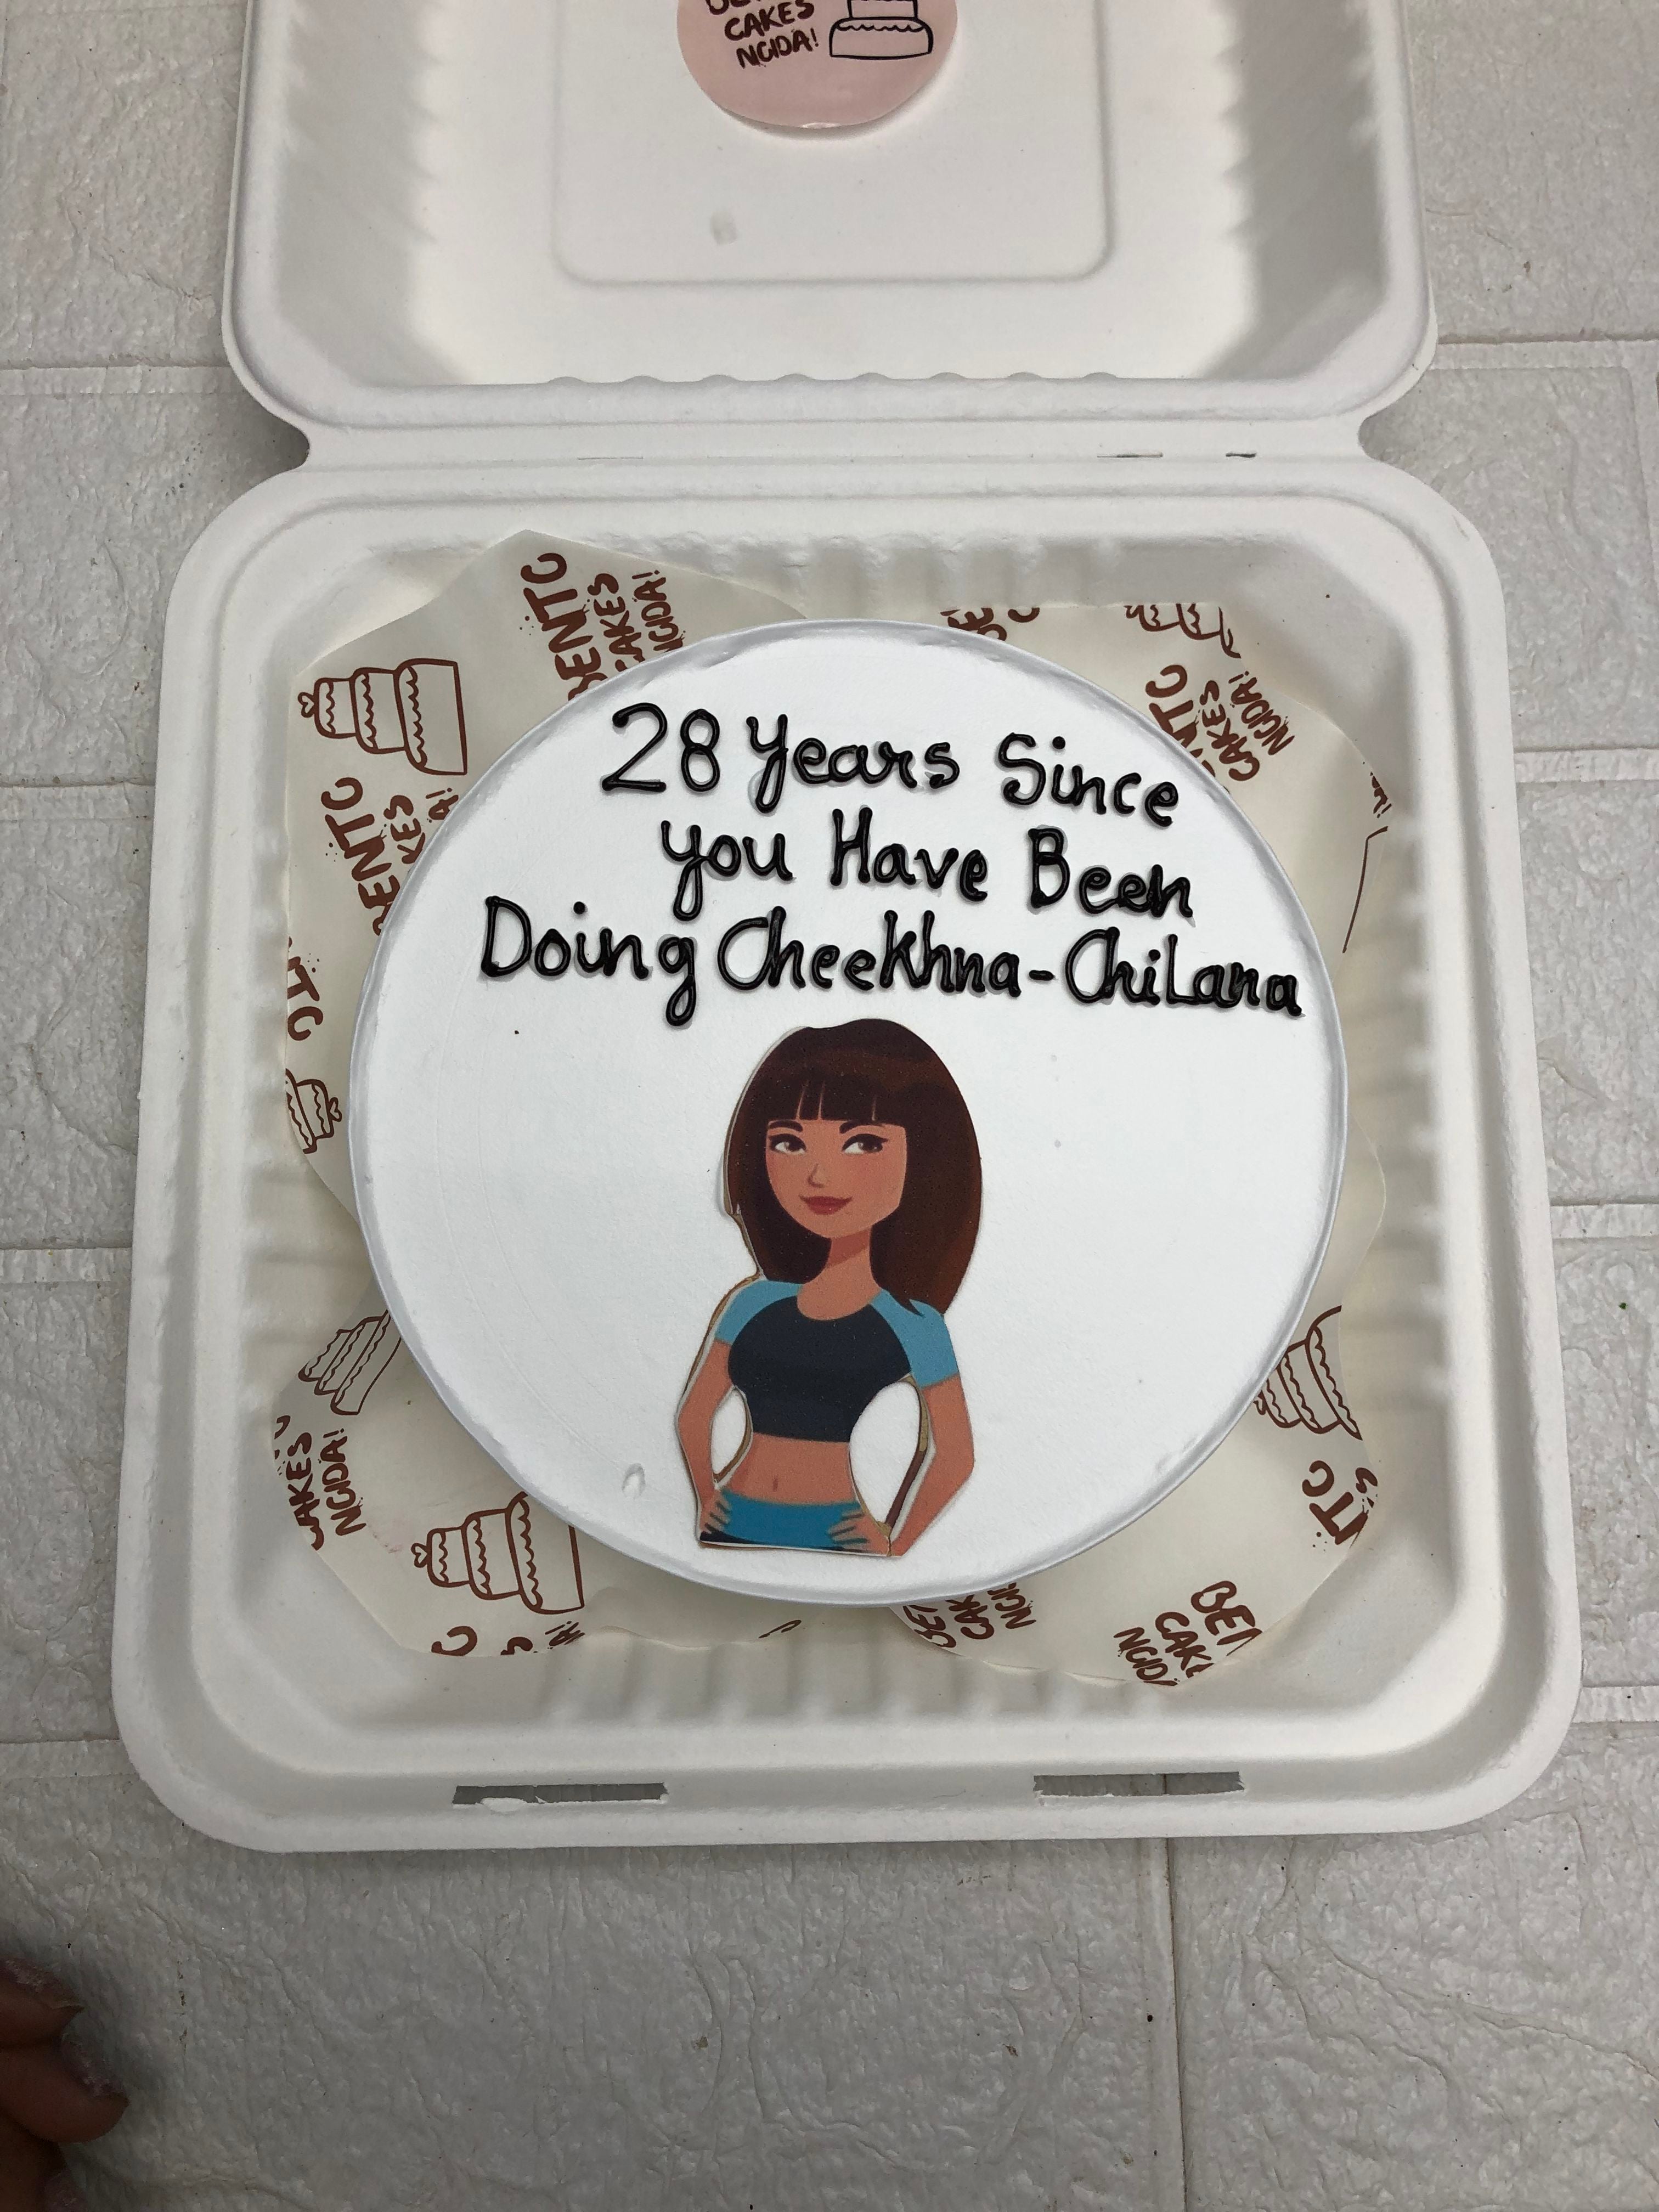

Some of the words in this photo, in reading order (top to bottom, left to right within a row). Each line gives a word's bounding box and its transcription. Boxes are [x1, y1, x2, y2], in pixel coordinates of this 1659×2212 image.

[724, 0, 815, 41] CAKES
[601, 702, 720, 792] 28
[997, 732, 1180, 827] Since
[1199, 680, 1260, 782] CAKES
[383, 794, 426, 865] KES
[830, 806, 988, 902] Have
[1028, 827, 1194, 918] Been
[481, 895, 697, 1026] Doing
[945, 1594, 995, 1640] CAK
